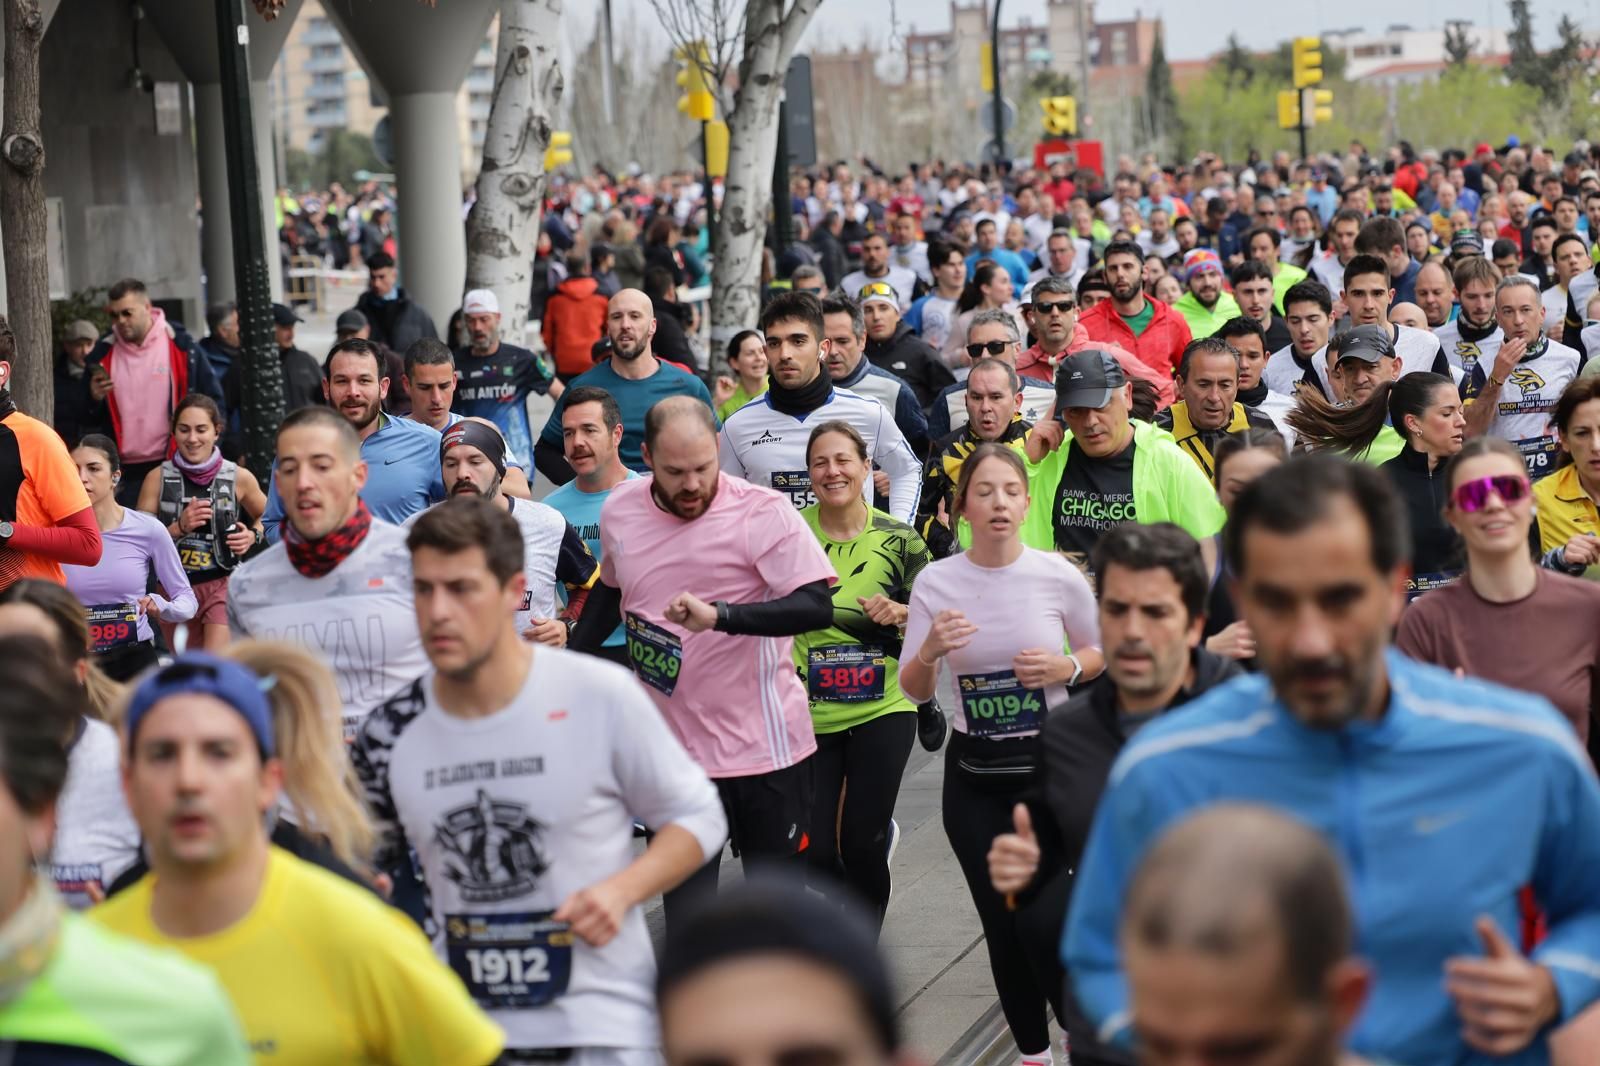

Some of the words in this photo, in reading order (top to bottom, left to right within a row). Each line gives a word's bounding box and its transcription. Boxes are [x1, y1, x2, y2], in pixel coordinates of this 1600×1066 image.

[752, 437, 782, 447] MERCURY
[1062, 489, 1087, 498] BANK
[1089, 492, 1100, 501] OF
[1061, 497, 1136, 520] CHICAGO
[627, 635, 679, 678] 10249
[818, 666, 875, 688] 3810
[966, 691, 1041, 719] 10194
[465, 947, 551, 985] 1912
